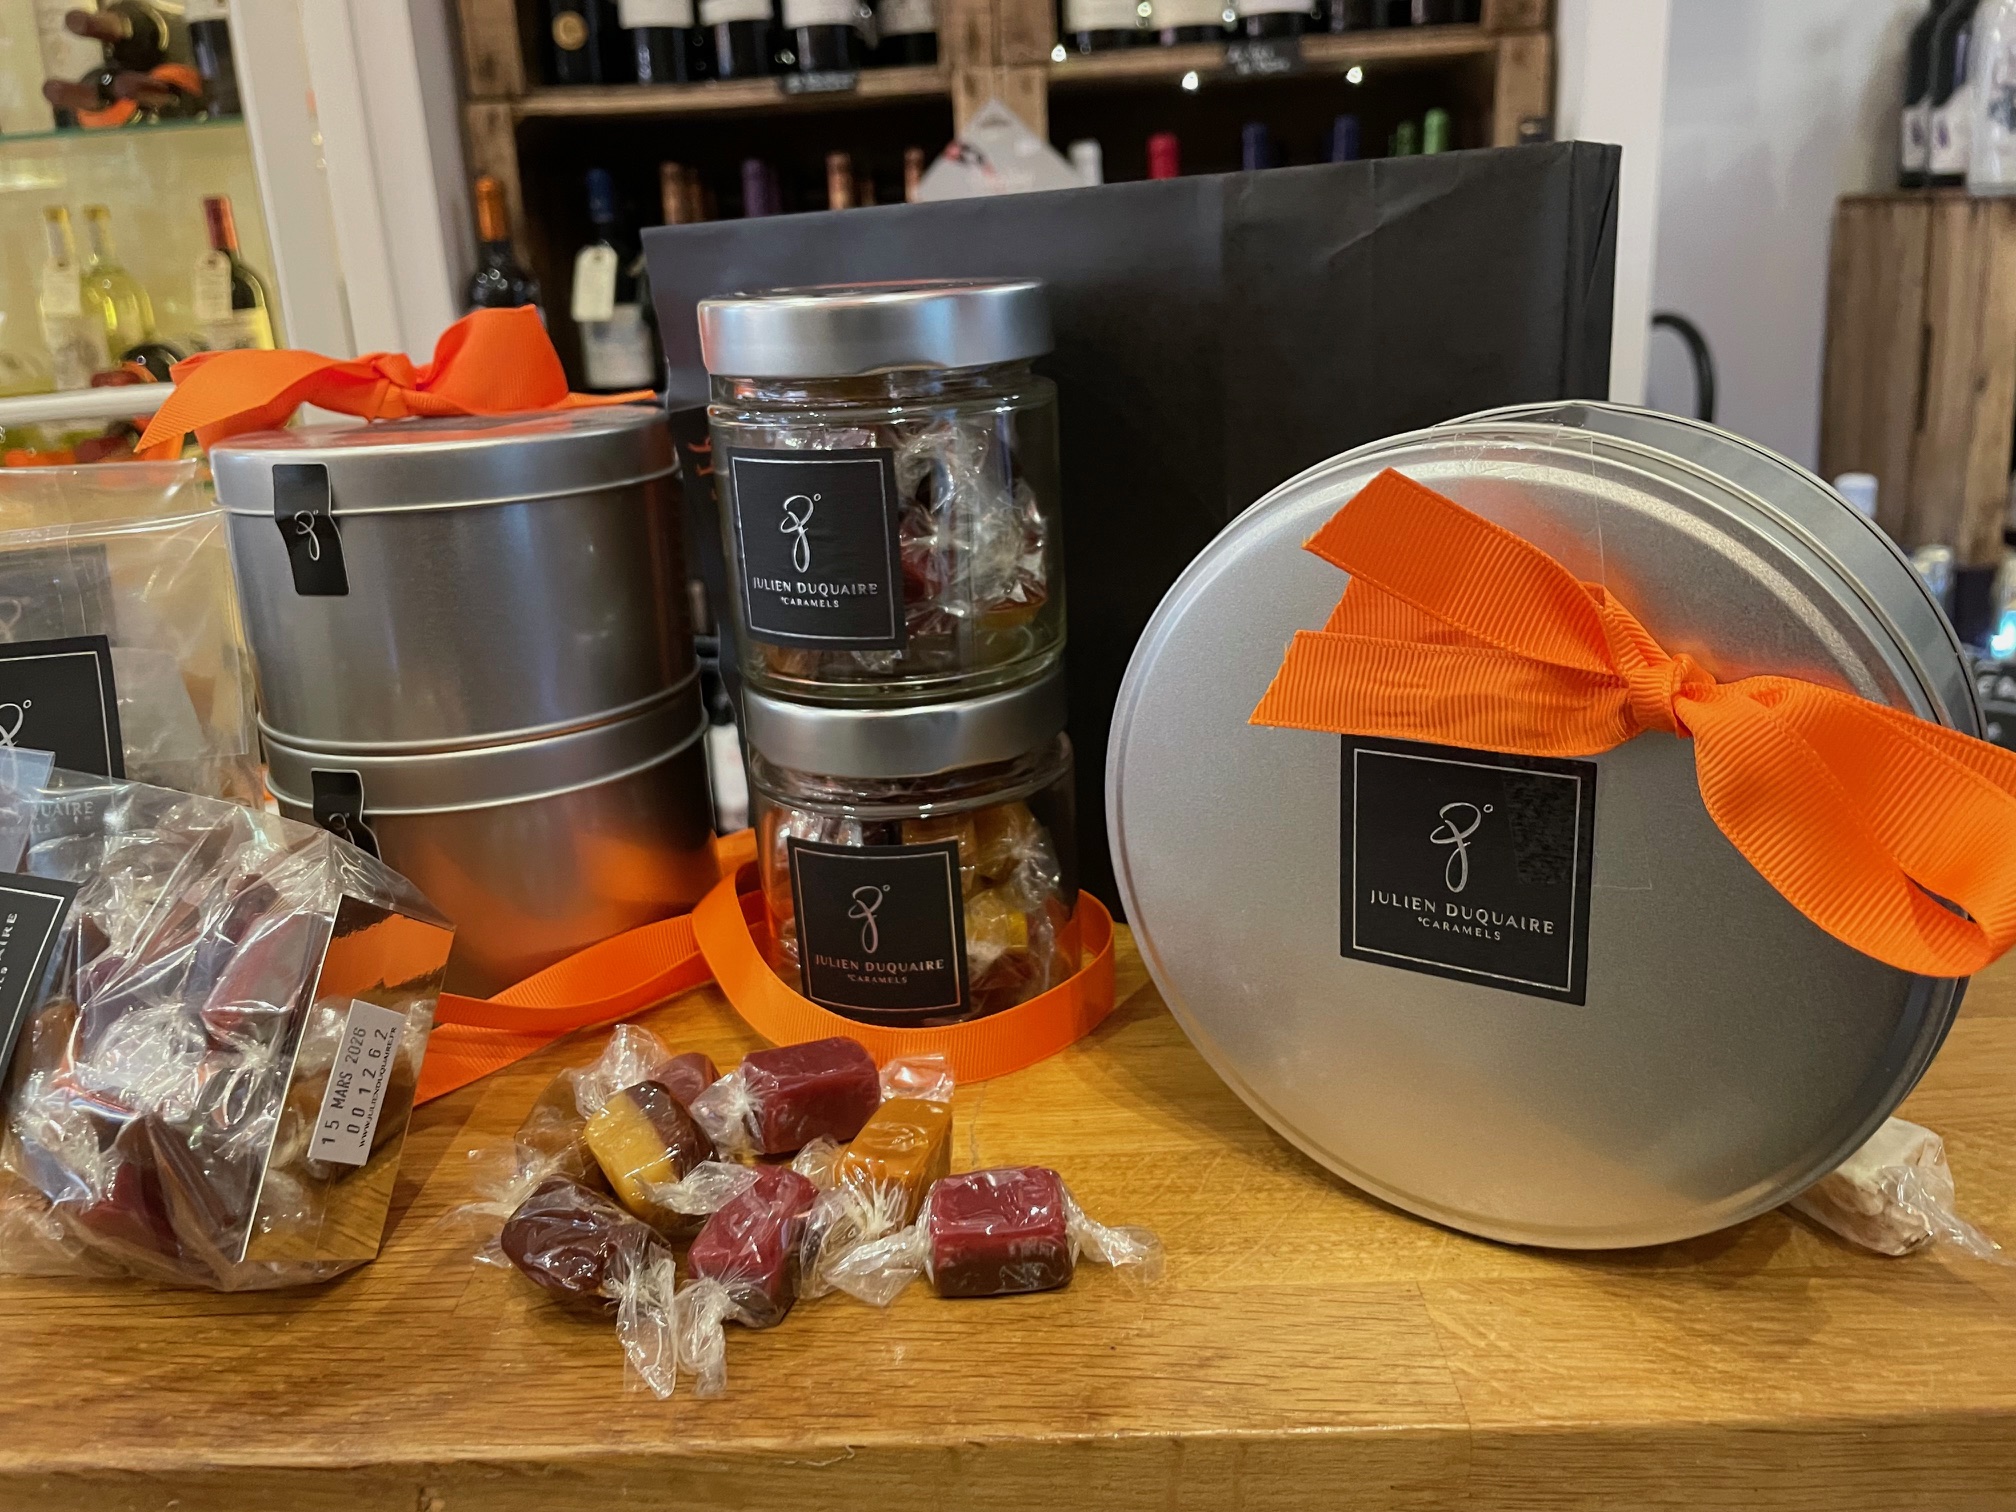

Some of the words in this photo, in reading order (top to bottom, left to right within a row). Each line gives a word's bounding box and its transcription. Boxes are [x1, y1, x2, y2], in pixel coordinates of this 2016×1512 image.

[753, 577, 792, 593] JULIEN
[797, 582, 878, 597] DUQUAIRE
[1370, 889, 1437, 914] JULIEN
[1446, 903, 1555, 935] DUQUAIRE
[815, 954, 859, 970] JULIEN
[865, 959, 945, 974] DUQUAIRE
[331, 1071, 353, 1110] MARS
[345, 1026, 367, 1065] 2026
